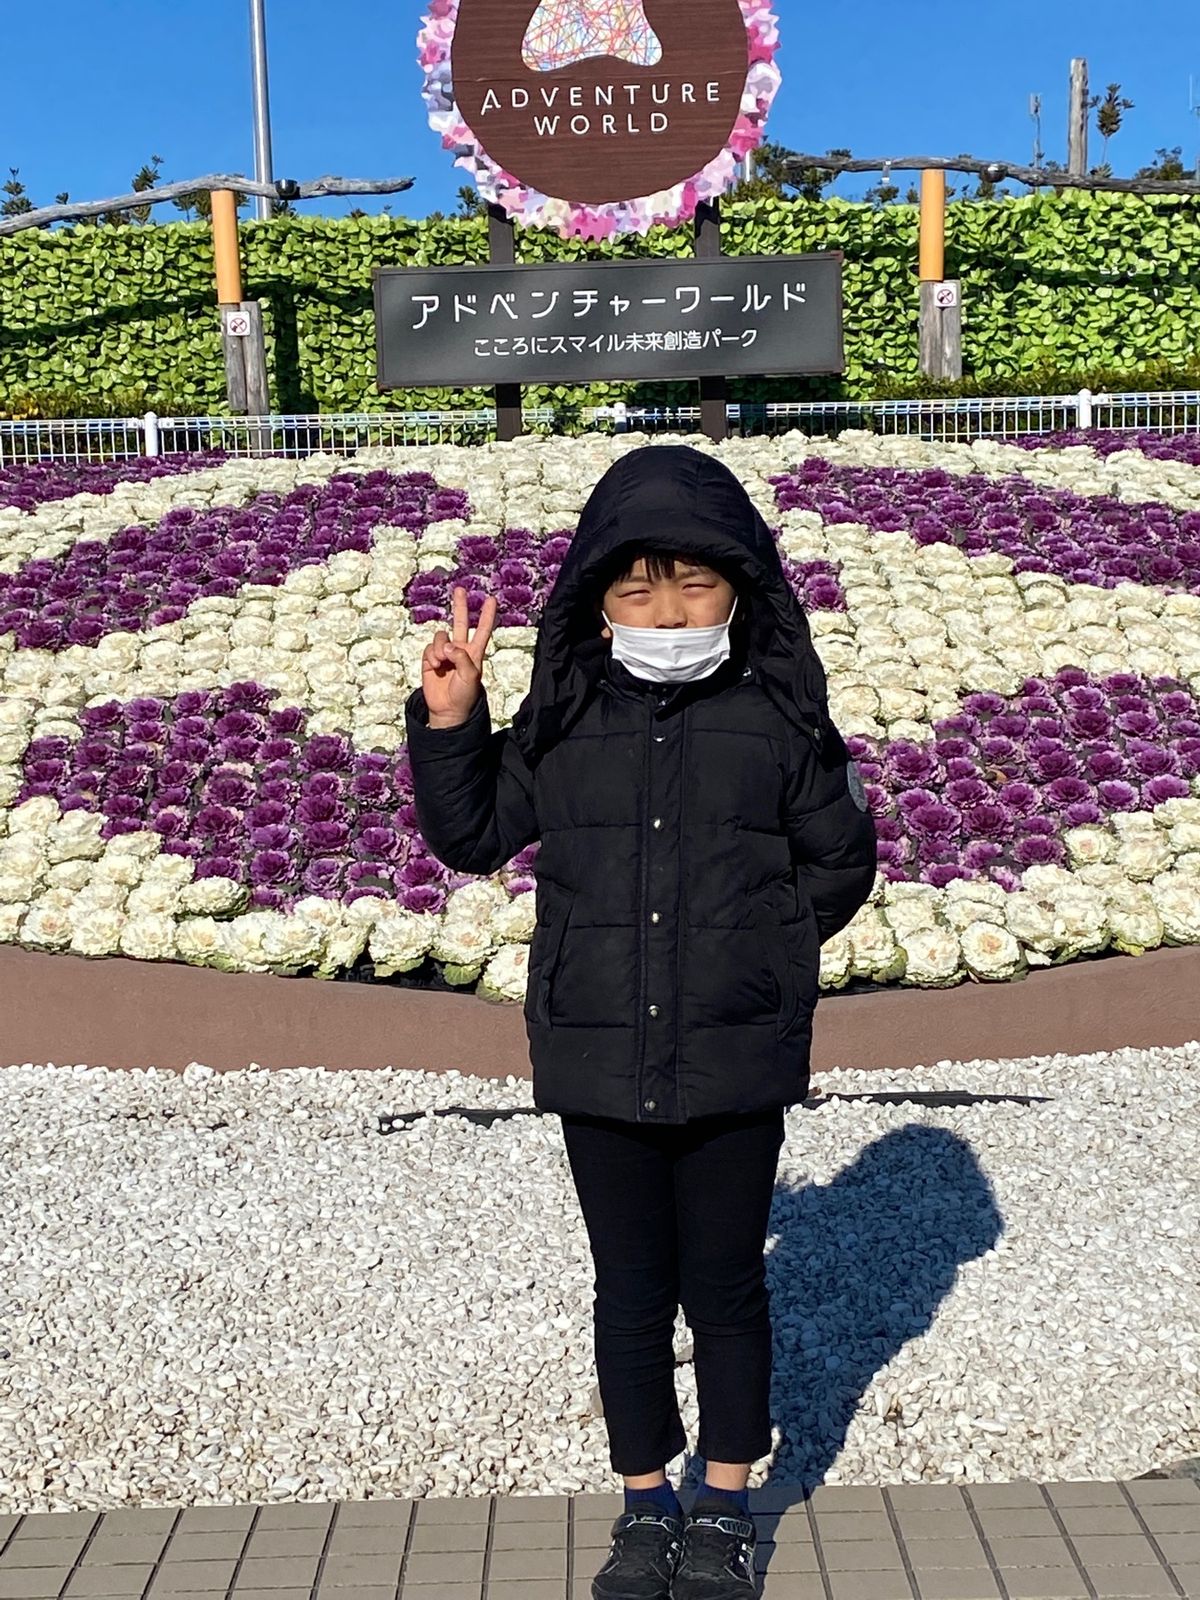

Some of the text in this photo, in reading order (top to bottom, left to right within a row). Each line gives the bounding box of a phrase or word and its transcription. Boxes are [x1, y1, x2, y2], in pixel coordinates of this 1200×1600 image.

[481, 81, 720, 116] ADVENTURE
[533, 112, 669, 136] WORLD
[411, 282, 807, 330] アドベンチャーワールド
[473, 328, 758, 357] こころにスマイル未来創造パーク
